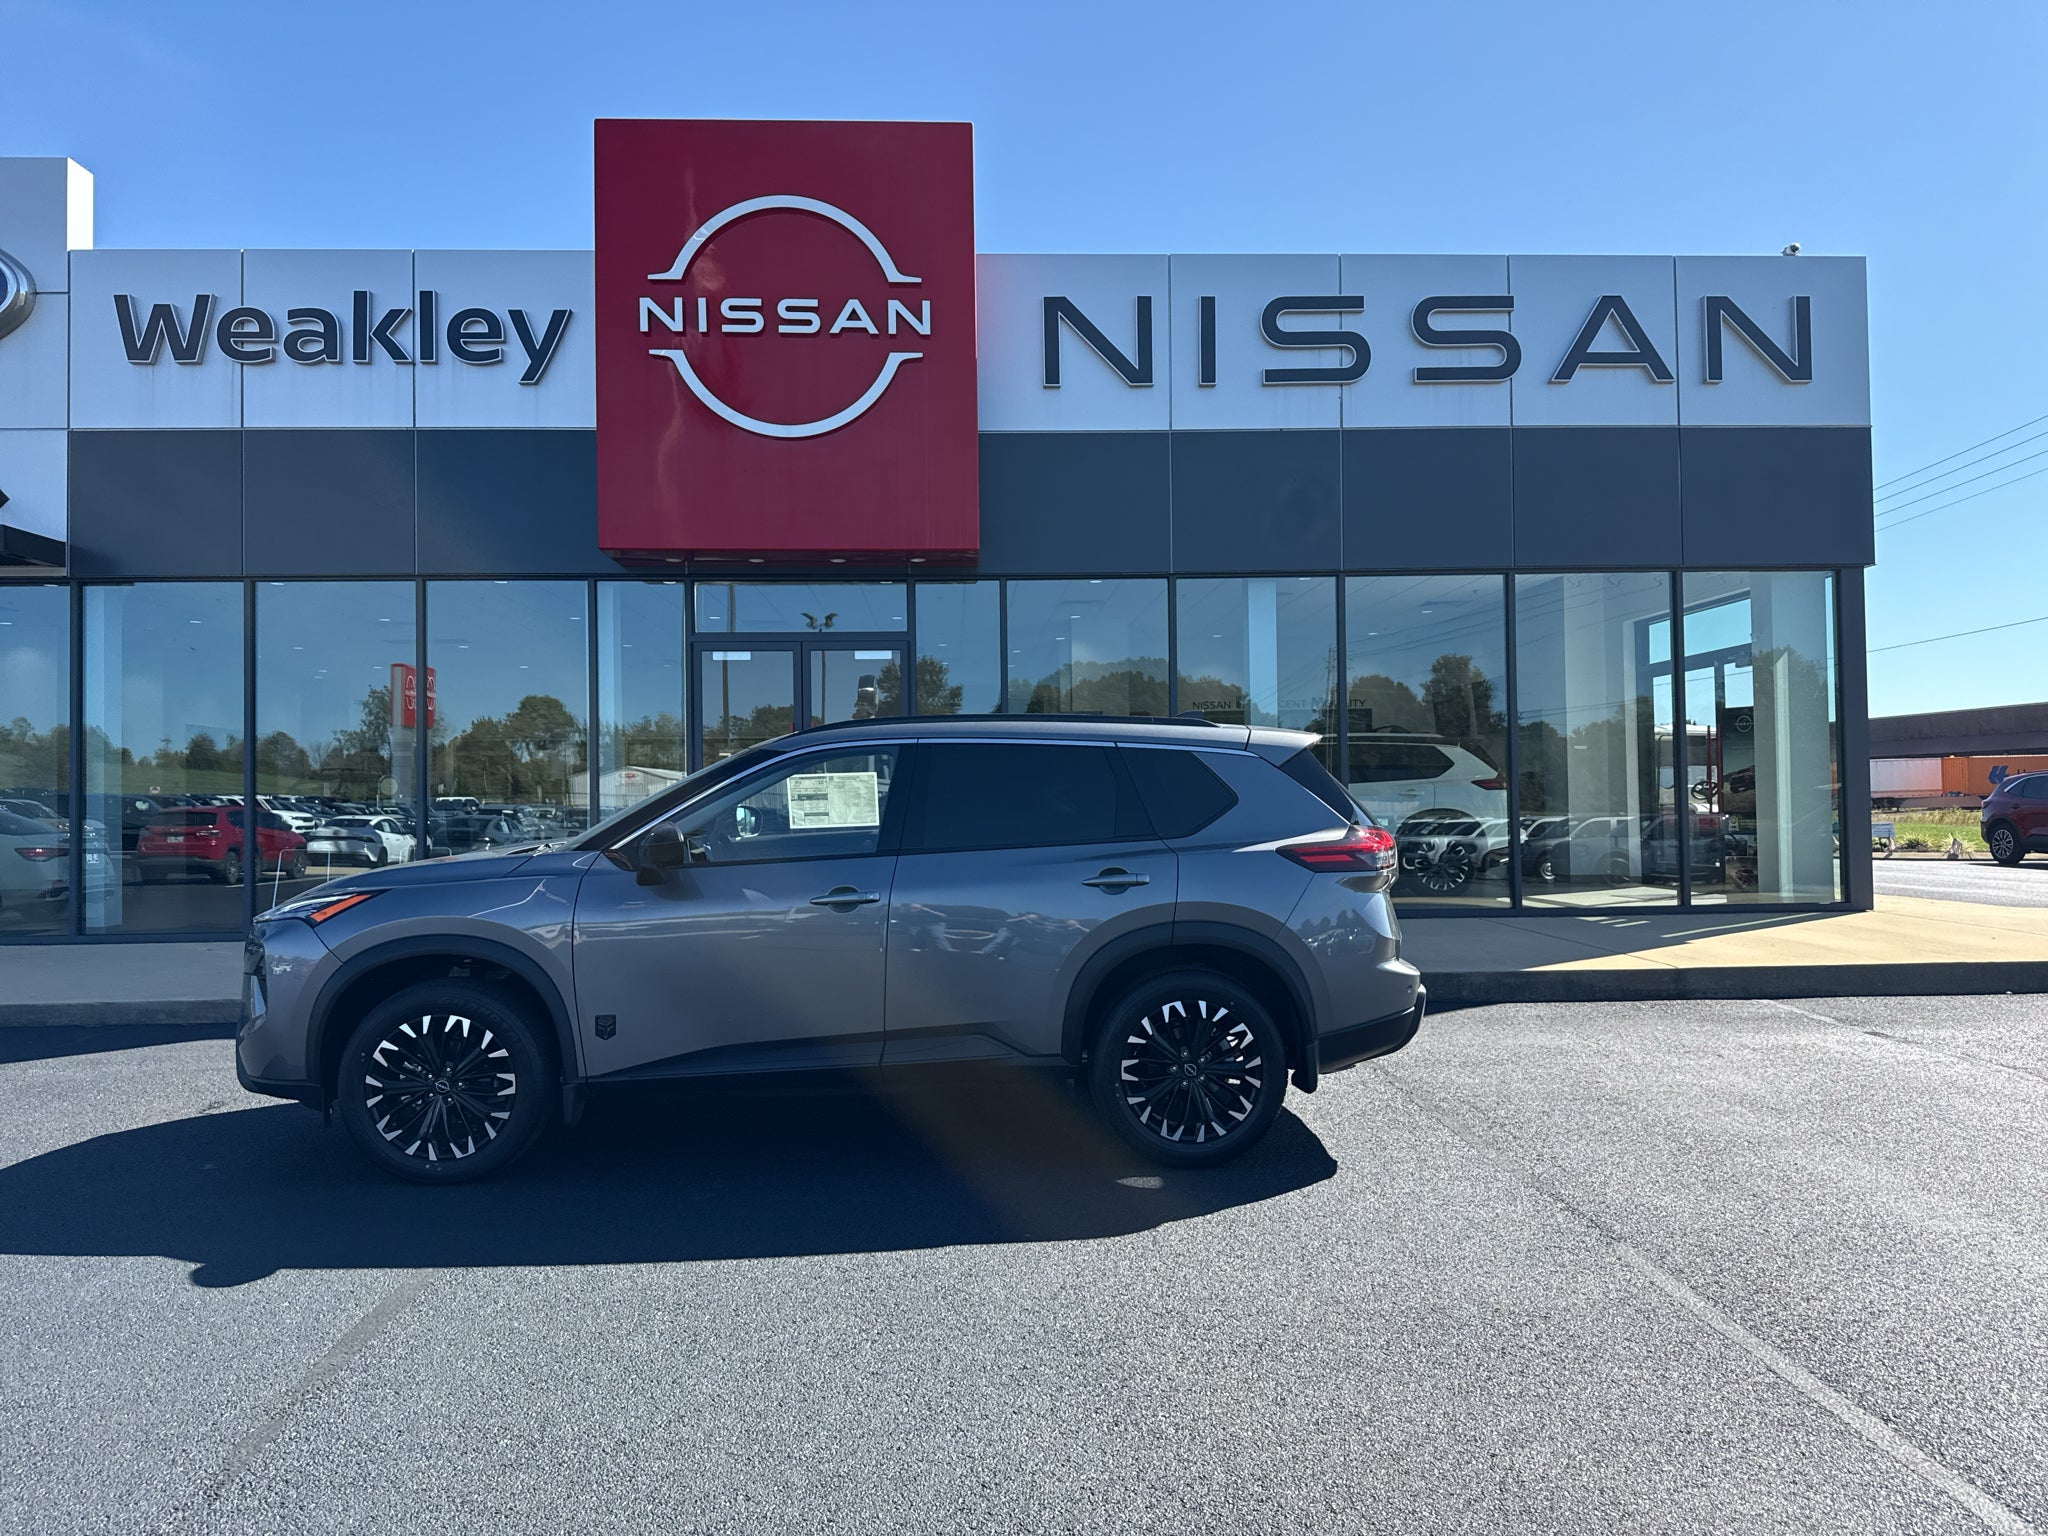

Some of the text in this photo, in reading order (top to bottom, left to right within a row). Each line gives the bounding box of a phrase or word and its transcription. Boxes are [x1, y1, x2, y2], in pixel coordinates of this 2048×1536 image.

[113, 289, 573, 386] Weakley
[639, 296, 932, 337] NISSAN
[1042, 294, 1814, 388] NISSAN
[1192, 700, 1232, 710] NISSAN
